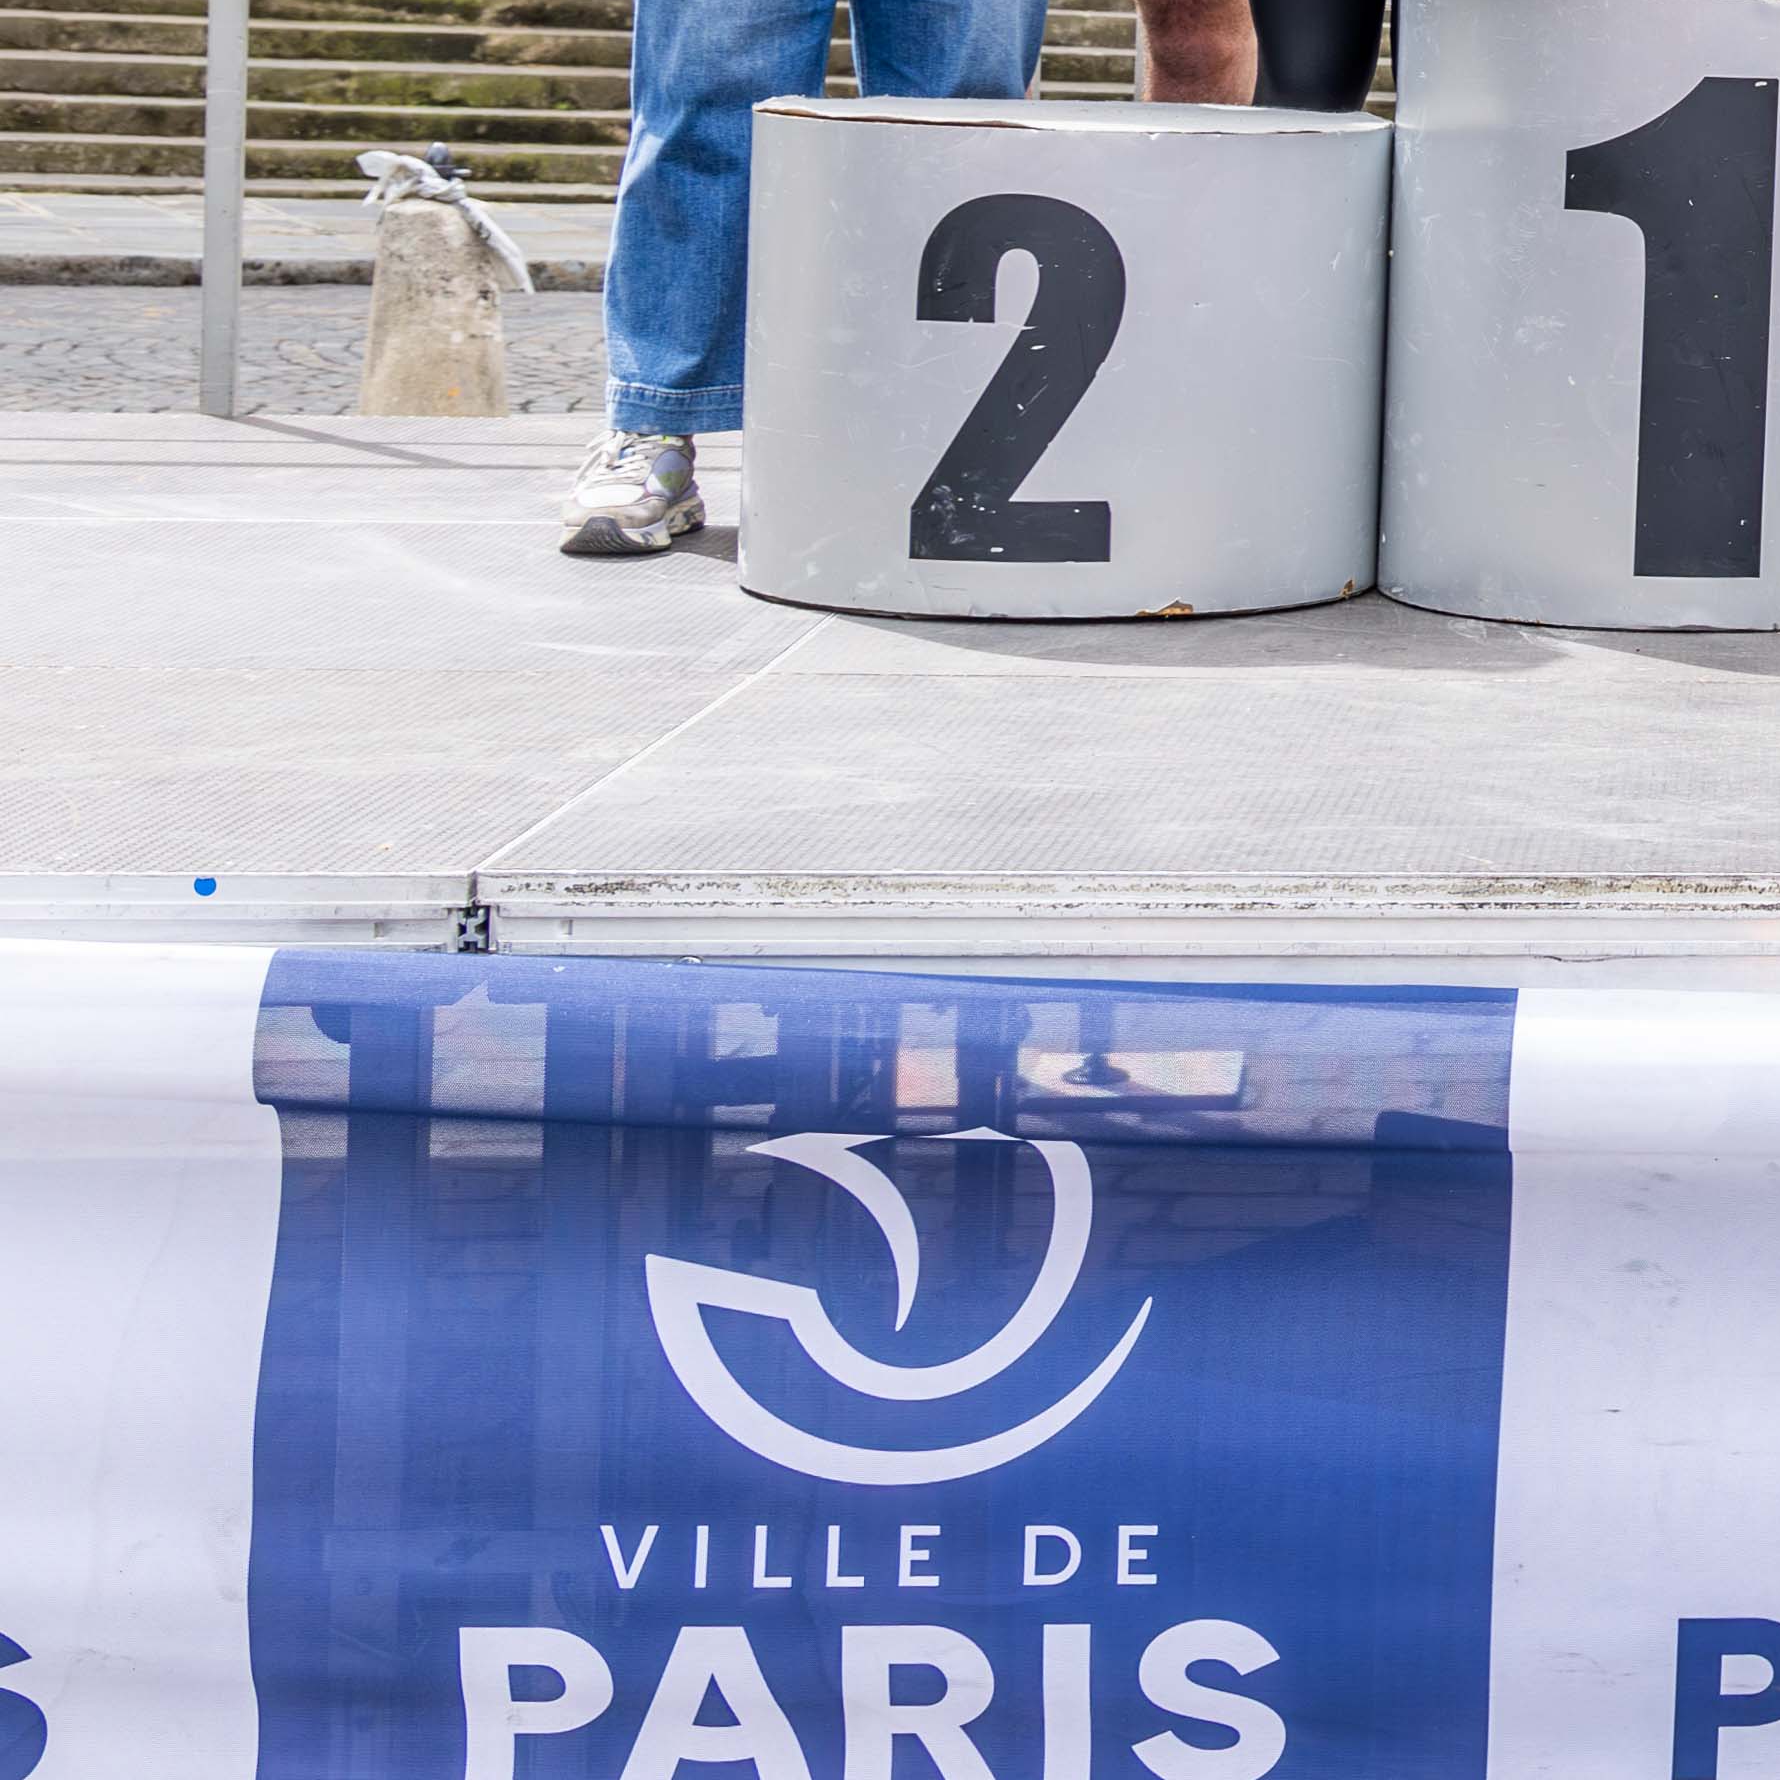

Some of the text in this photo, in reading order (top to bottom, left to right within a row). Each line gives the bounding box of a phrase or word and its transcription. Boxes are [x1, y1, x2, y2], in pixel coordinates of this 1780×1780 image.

[909, 194, 1126, 563] 2
[1563, 77, 1779, 578] 1
[601, 1524, 1158, 1589] VILLE DE
[459, 1619, 1286, 1780] PARIS
